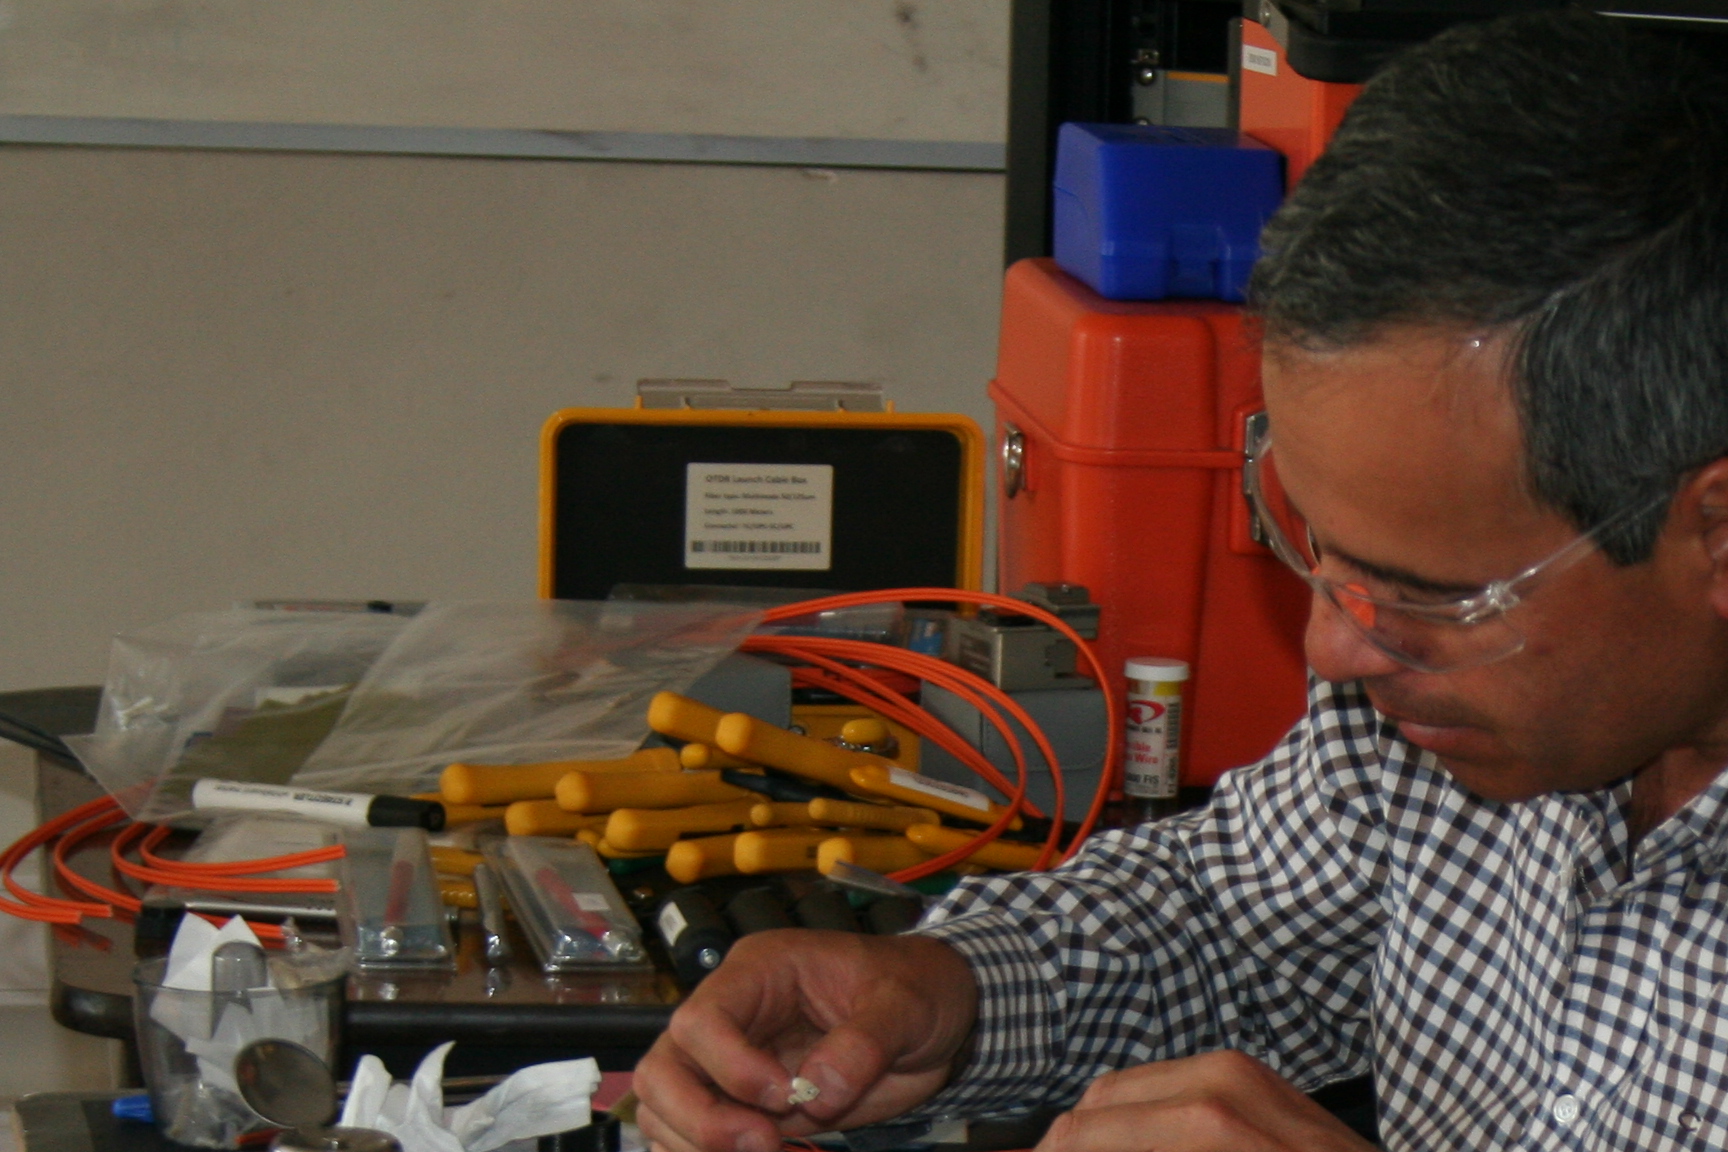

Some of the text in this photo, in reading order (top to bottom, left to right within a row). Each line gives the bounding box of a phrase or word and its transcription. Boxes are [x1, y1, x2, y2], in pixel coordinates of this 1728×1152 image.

[733, 475, 763, 483] Launch
[791, 476, 807, 484] Box
[1136, 754, 1158, 764] Wire
[1144, 774, 1159, 784] FIS
